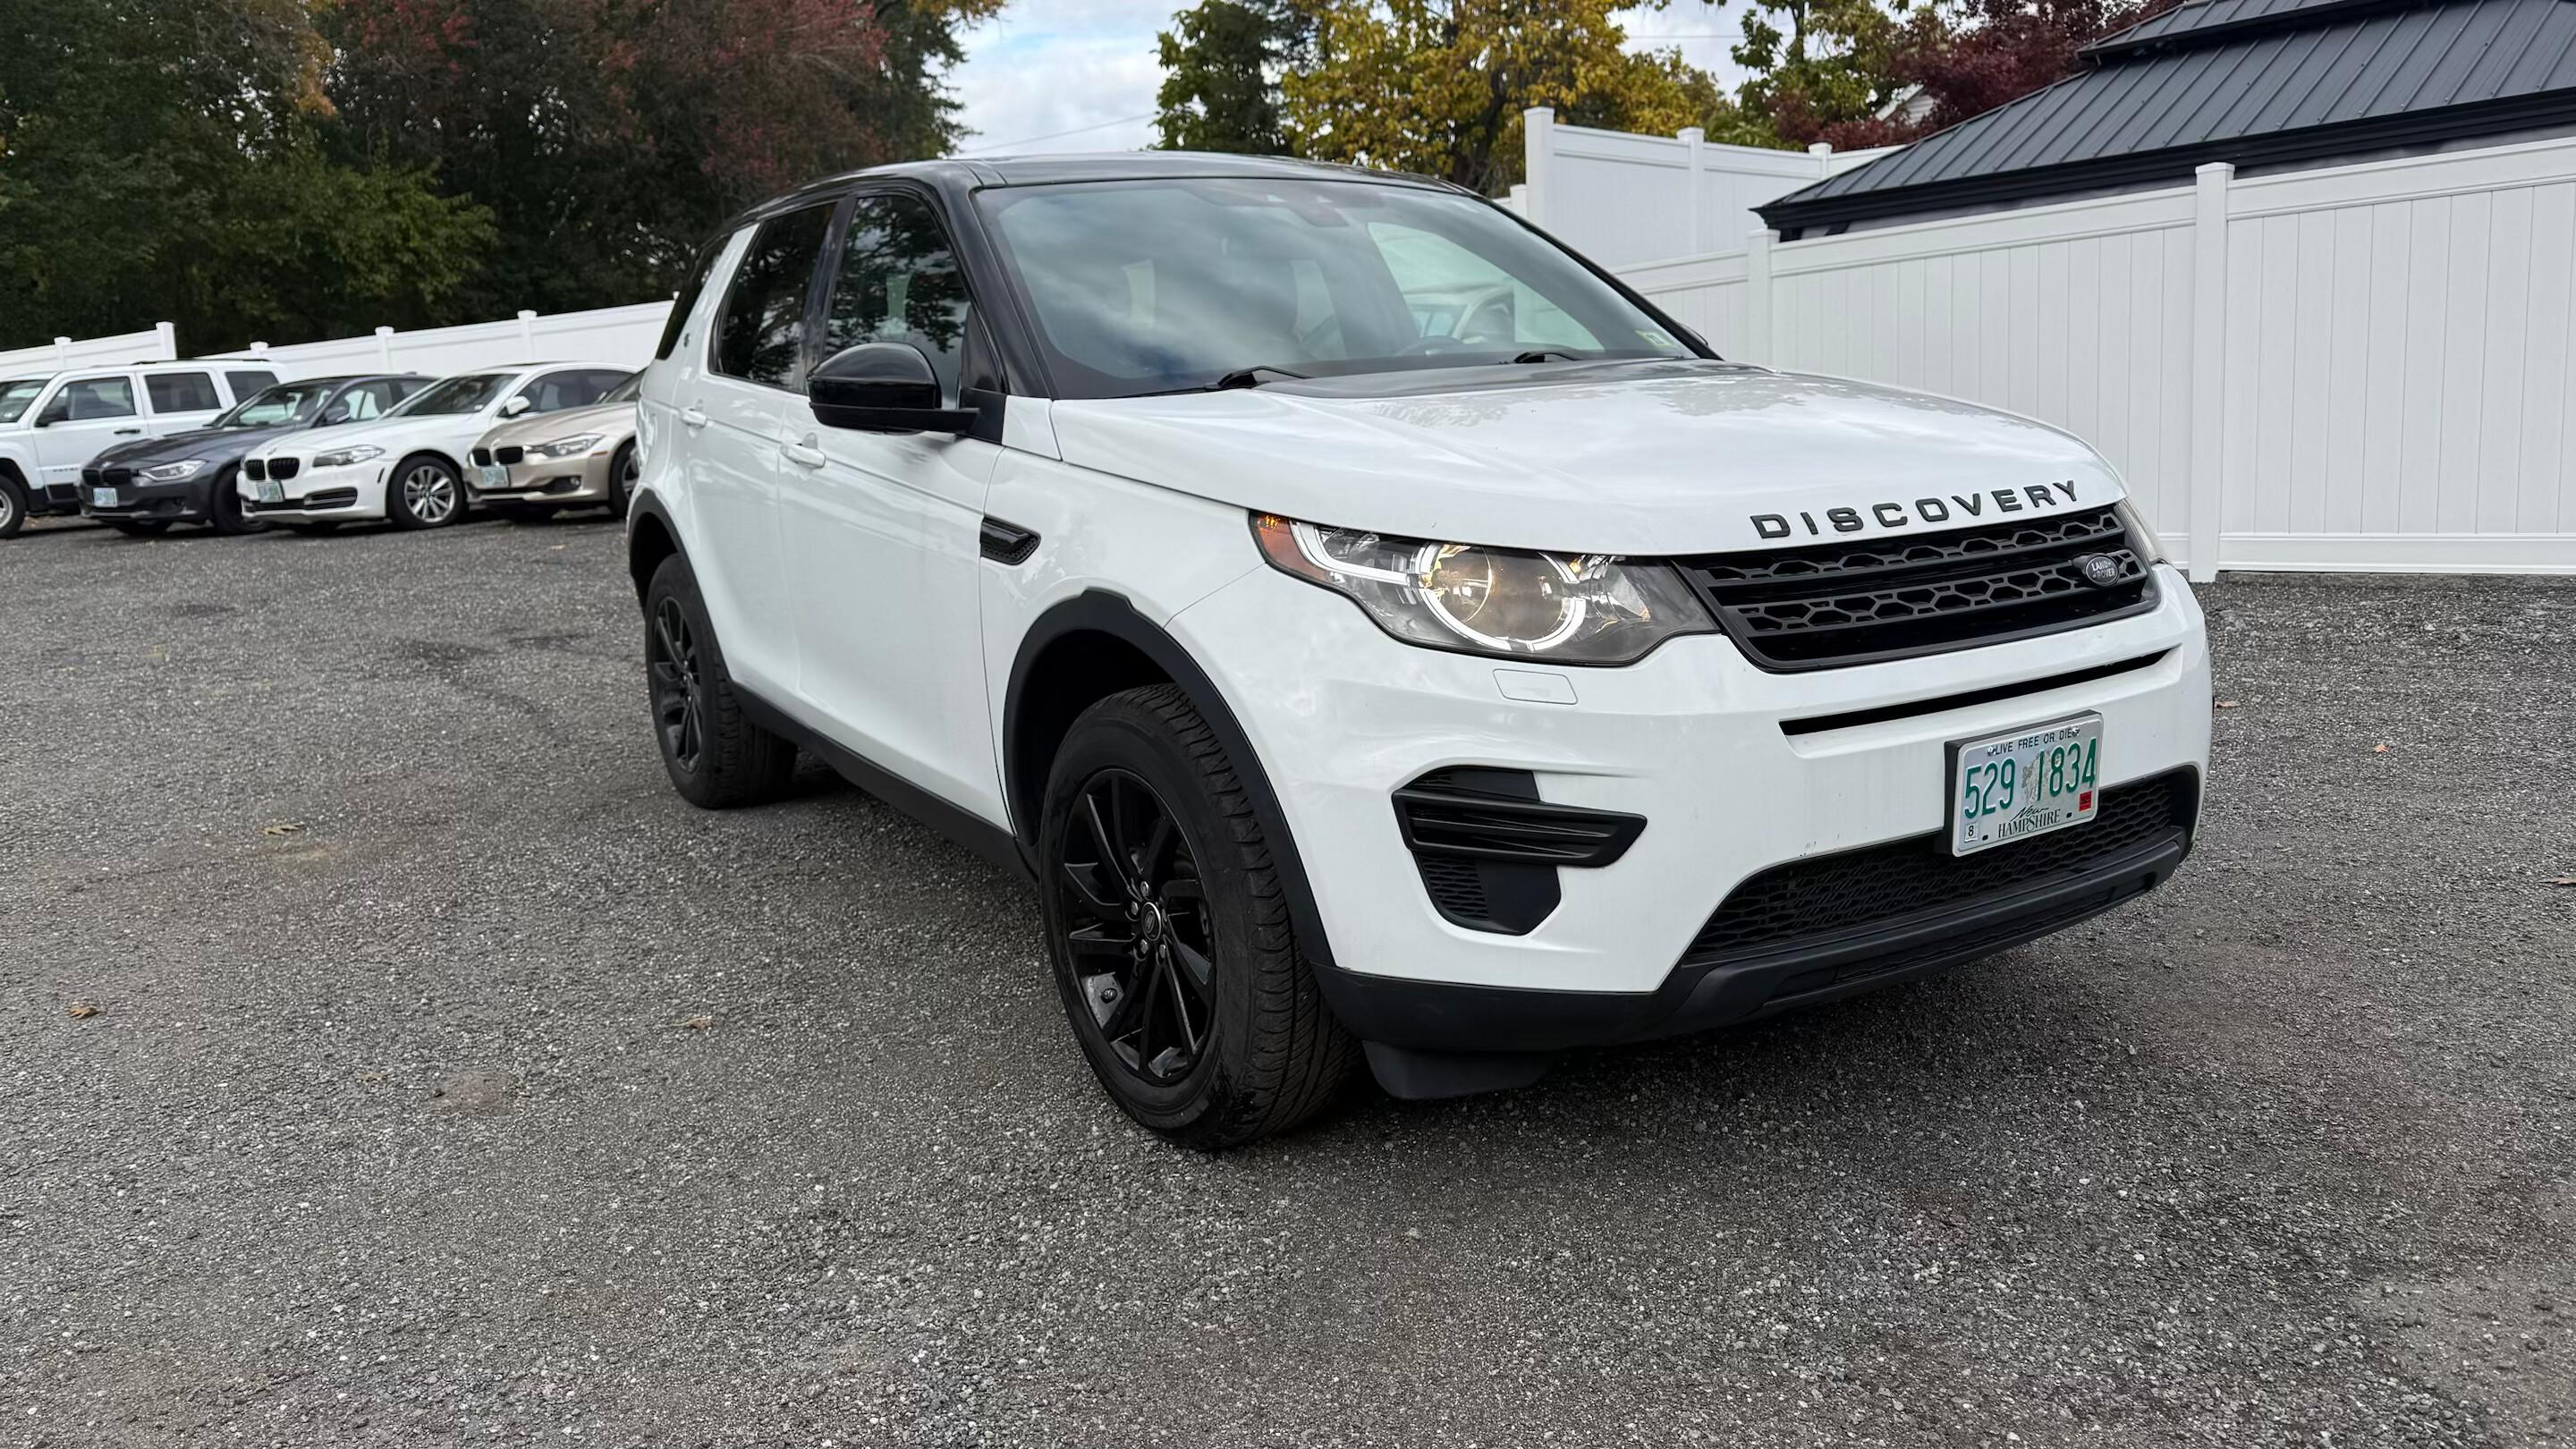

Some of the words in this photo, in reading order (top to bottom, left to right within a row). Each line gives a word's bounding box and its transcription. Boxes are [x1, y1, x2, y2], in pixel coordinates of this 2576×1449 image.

[1750, 479, 2078, 539] DISCOVERY
[1995, 741, 2013, 756] LIVE
[2018, 736, 2039, 750] FREE
[2043, 732, 2055, 743] OR
[2059, 728, 2072, 741] DIE
[1964, 758, 2016, 819] 529
[2037, 738, 2097, 801] 1834
[1968, 825, 1974, 837] 8
[1998, 809, 2062, 838] HAMPSHIRE
